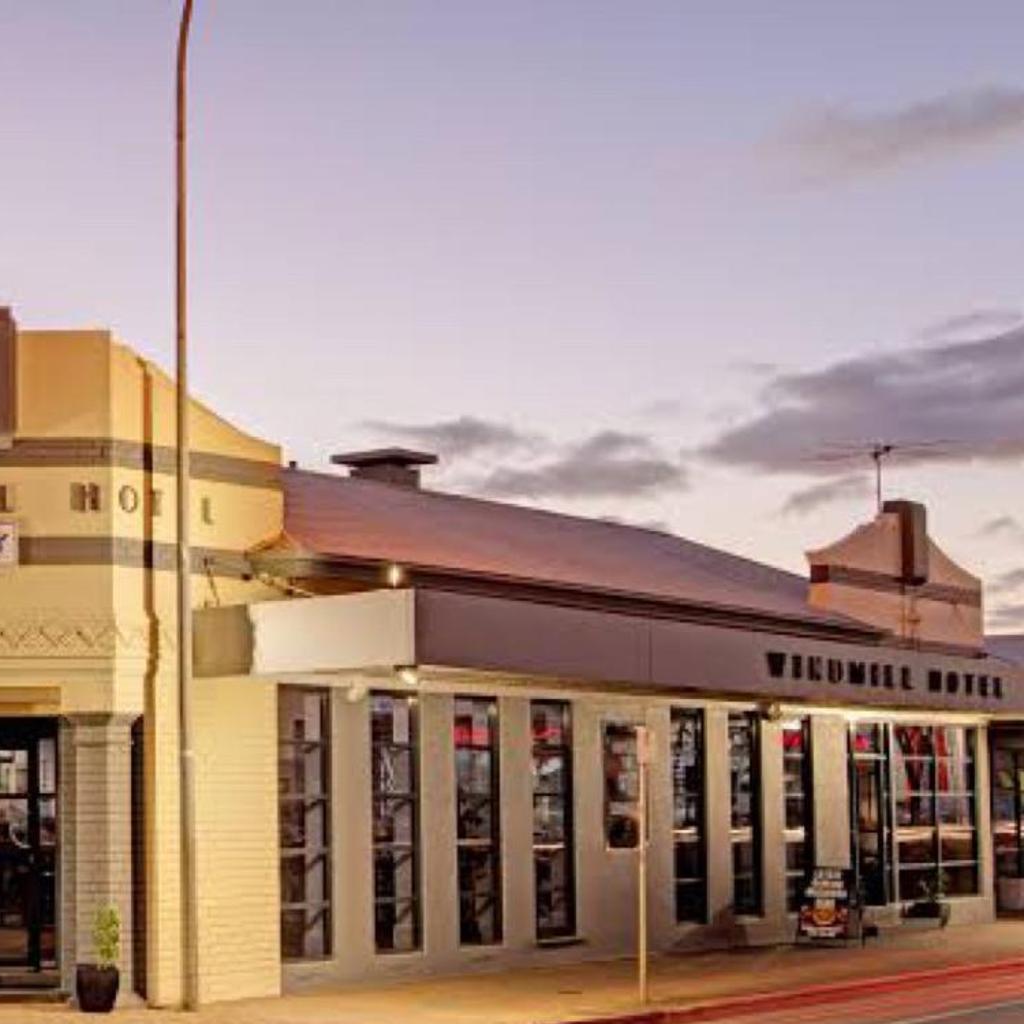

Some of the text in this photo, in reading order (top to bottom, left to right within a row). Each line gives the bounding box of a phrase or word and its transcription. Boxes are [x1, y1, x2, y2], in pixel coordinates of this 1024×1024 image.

[69, 482, 213, 525] HOTL
[765, 652, 1003, 699] WINDMILL HOTEL
